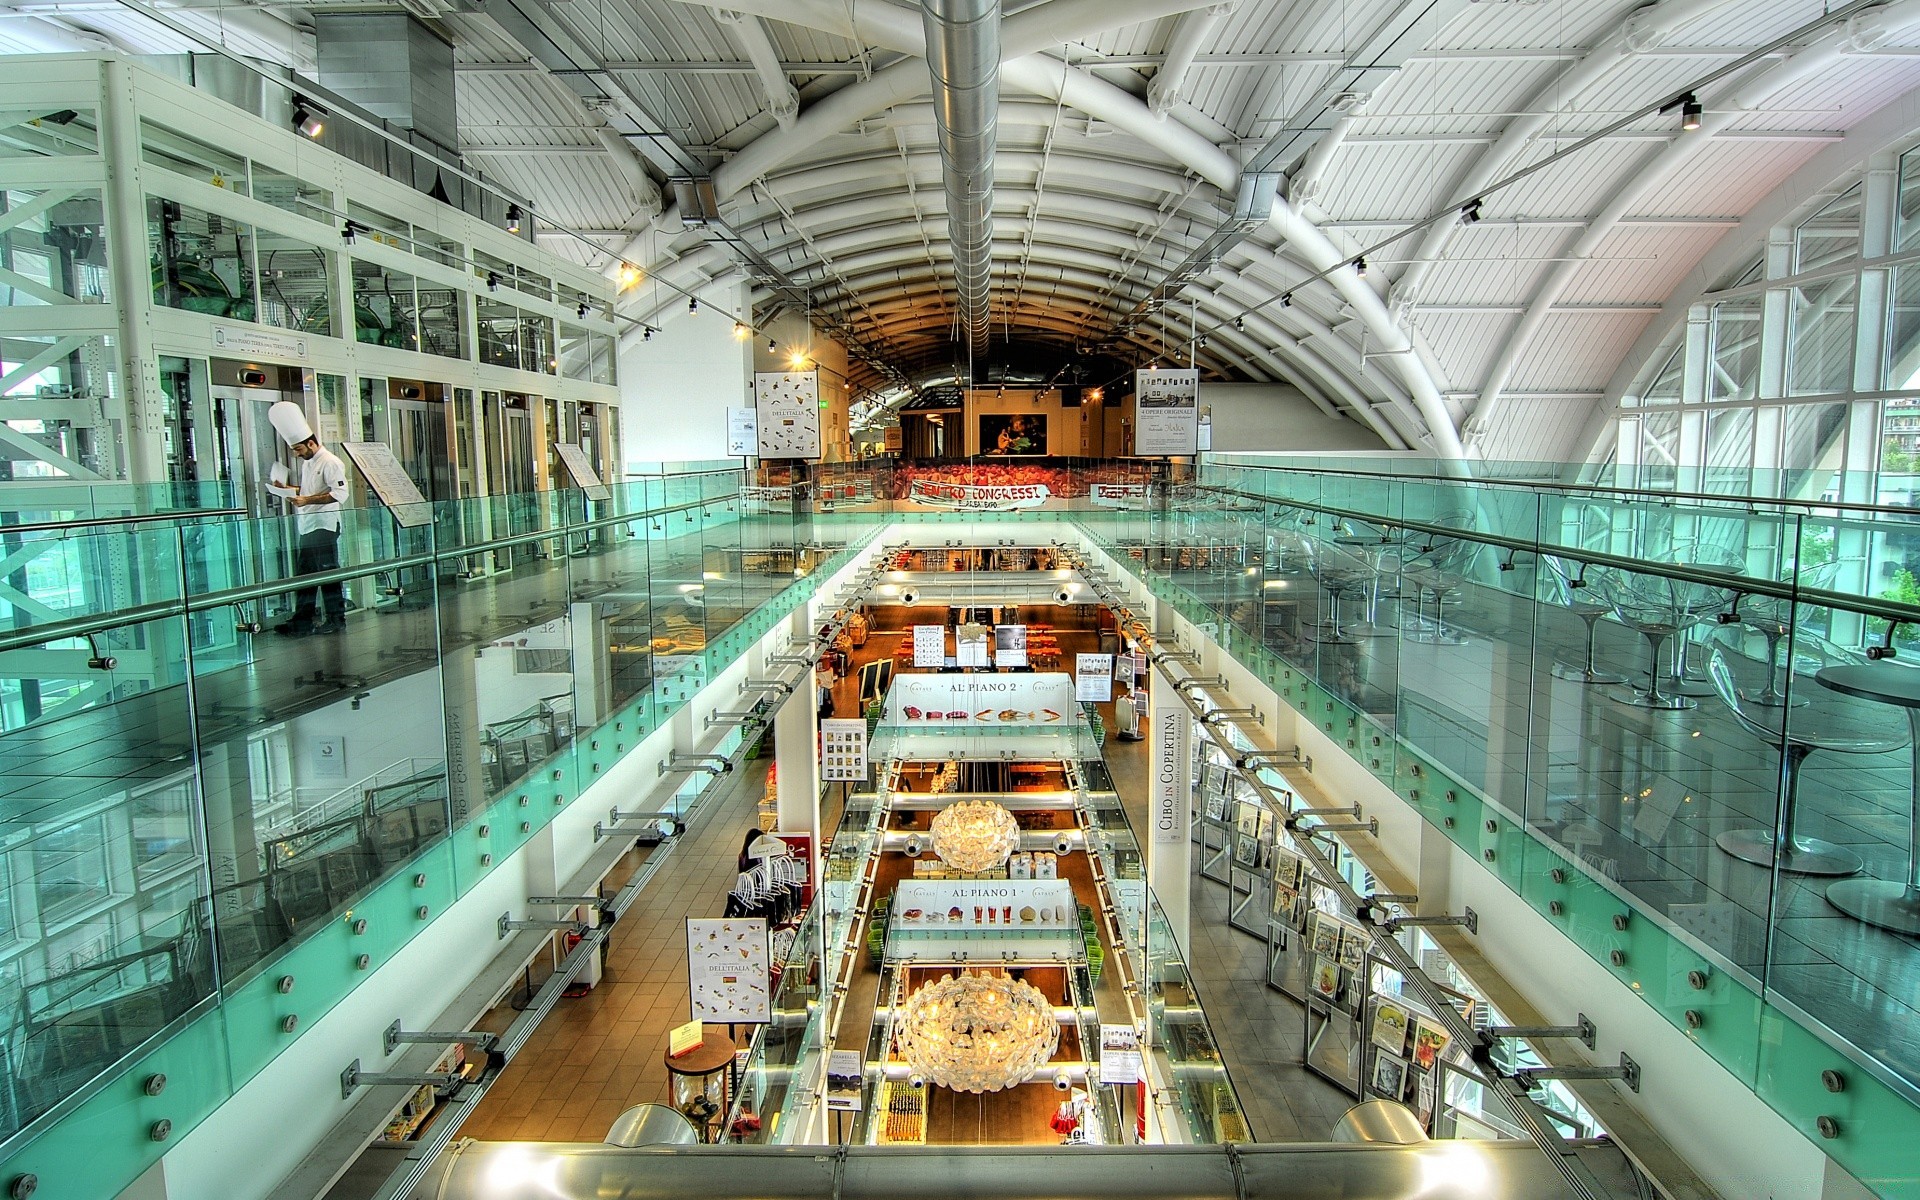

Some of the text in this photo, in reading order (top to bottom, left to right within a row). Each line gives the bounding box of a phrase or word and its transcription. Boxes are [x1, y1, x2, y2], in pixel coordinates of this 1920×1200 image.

[917, 483, 1040, 500] CENTRO CONGRESSI
[1160, 714, 1175, 784] COPERTINA
[1165, 787, 1173, 796] IN
[1159, 799, 1173, 830] CIBO
